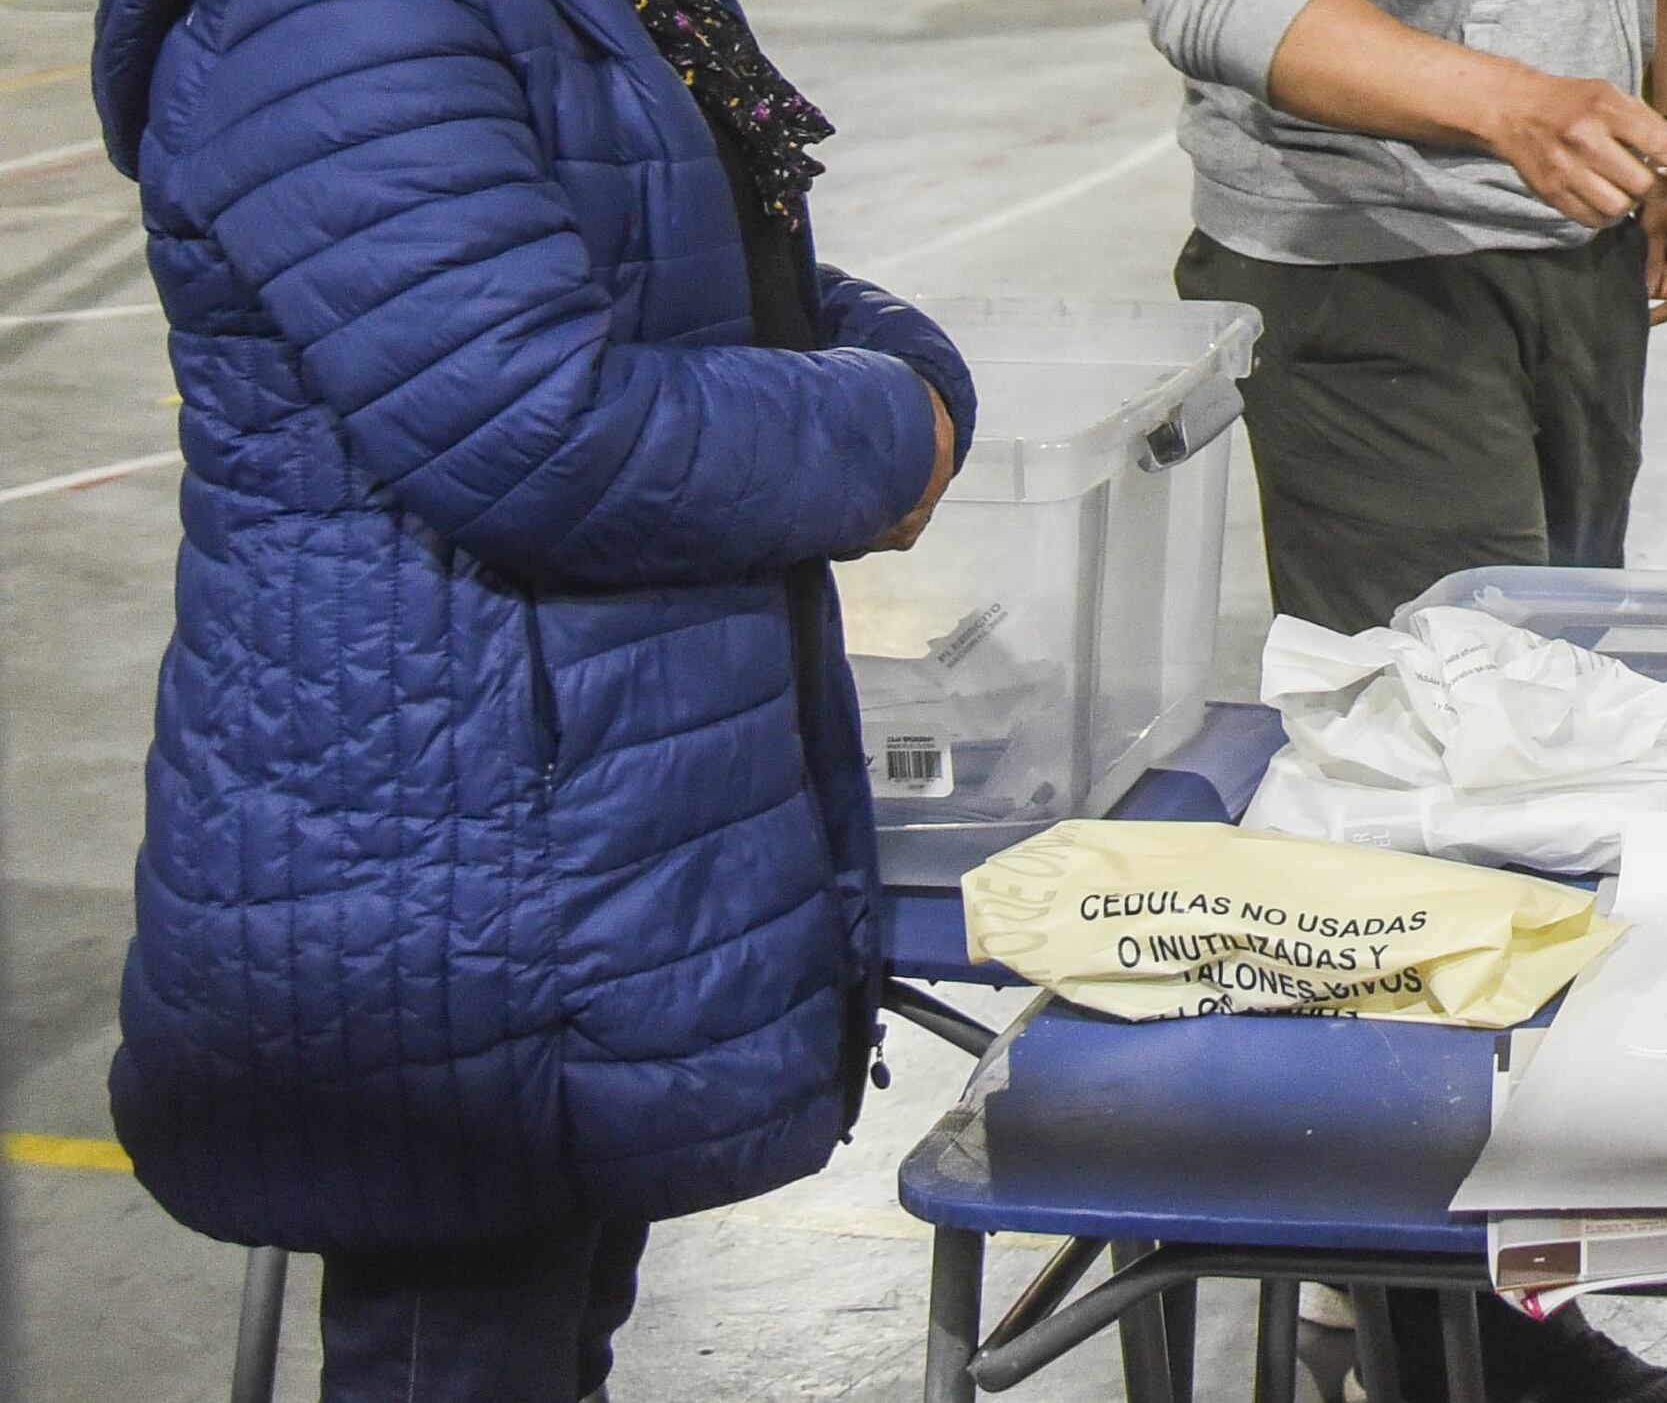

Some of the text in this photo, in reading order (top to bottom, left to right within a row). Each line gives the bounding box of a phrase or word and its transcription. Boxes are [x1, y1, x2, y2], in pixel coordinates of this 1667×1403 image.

[1241, 901, 1288, 926] NO
[1298, 910, 1427, 939] USADAS
[1118, 932, 1389, 971] O INUTILIZADAS Y
